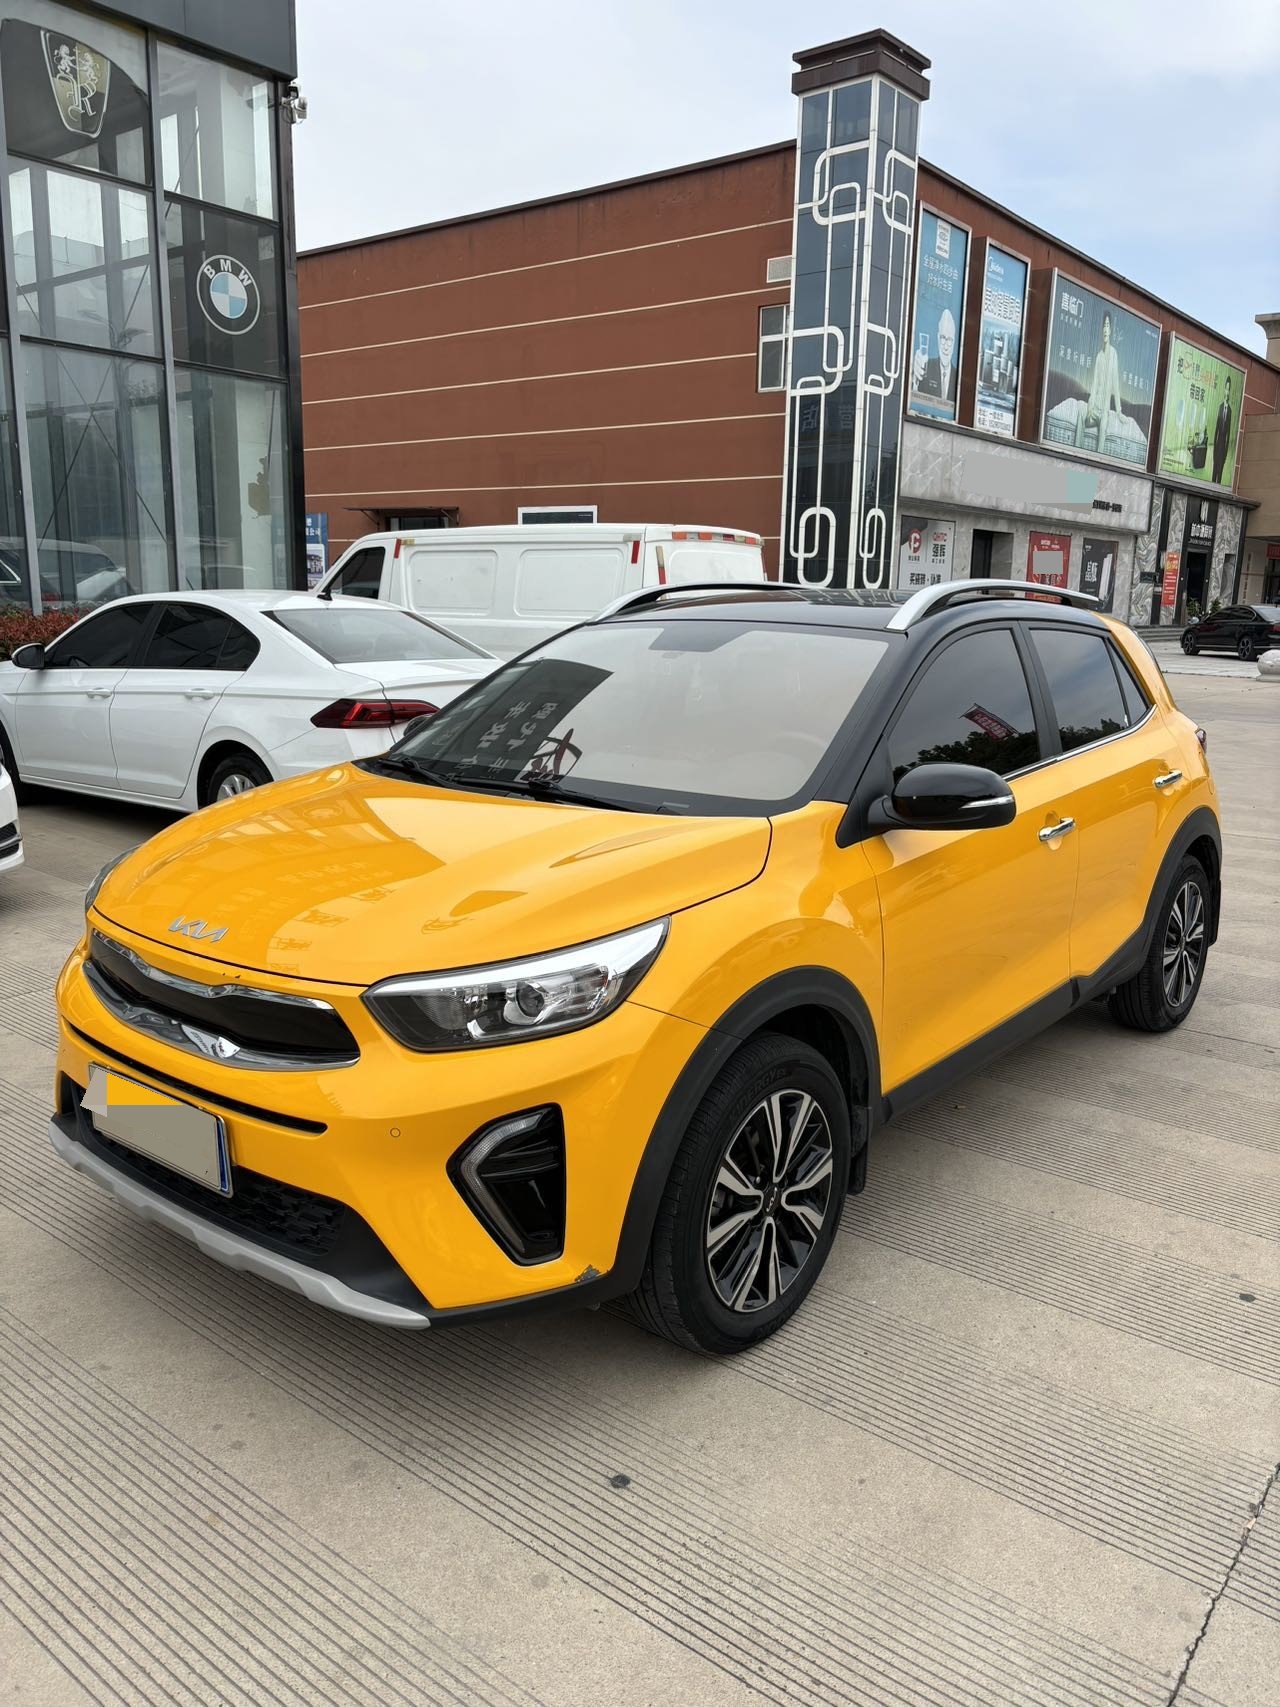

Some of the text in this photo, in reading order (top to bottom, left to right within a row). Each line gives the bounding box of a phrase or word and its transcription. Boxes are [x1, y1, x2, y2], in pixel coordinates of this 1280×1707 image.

[203, 259, 252, 287] BMW
[1061, 292, 1084, 318] 喜临门
